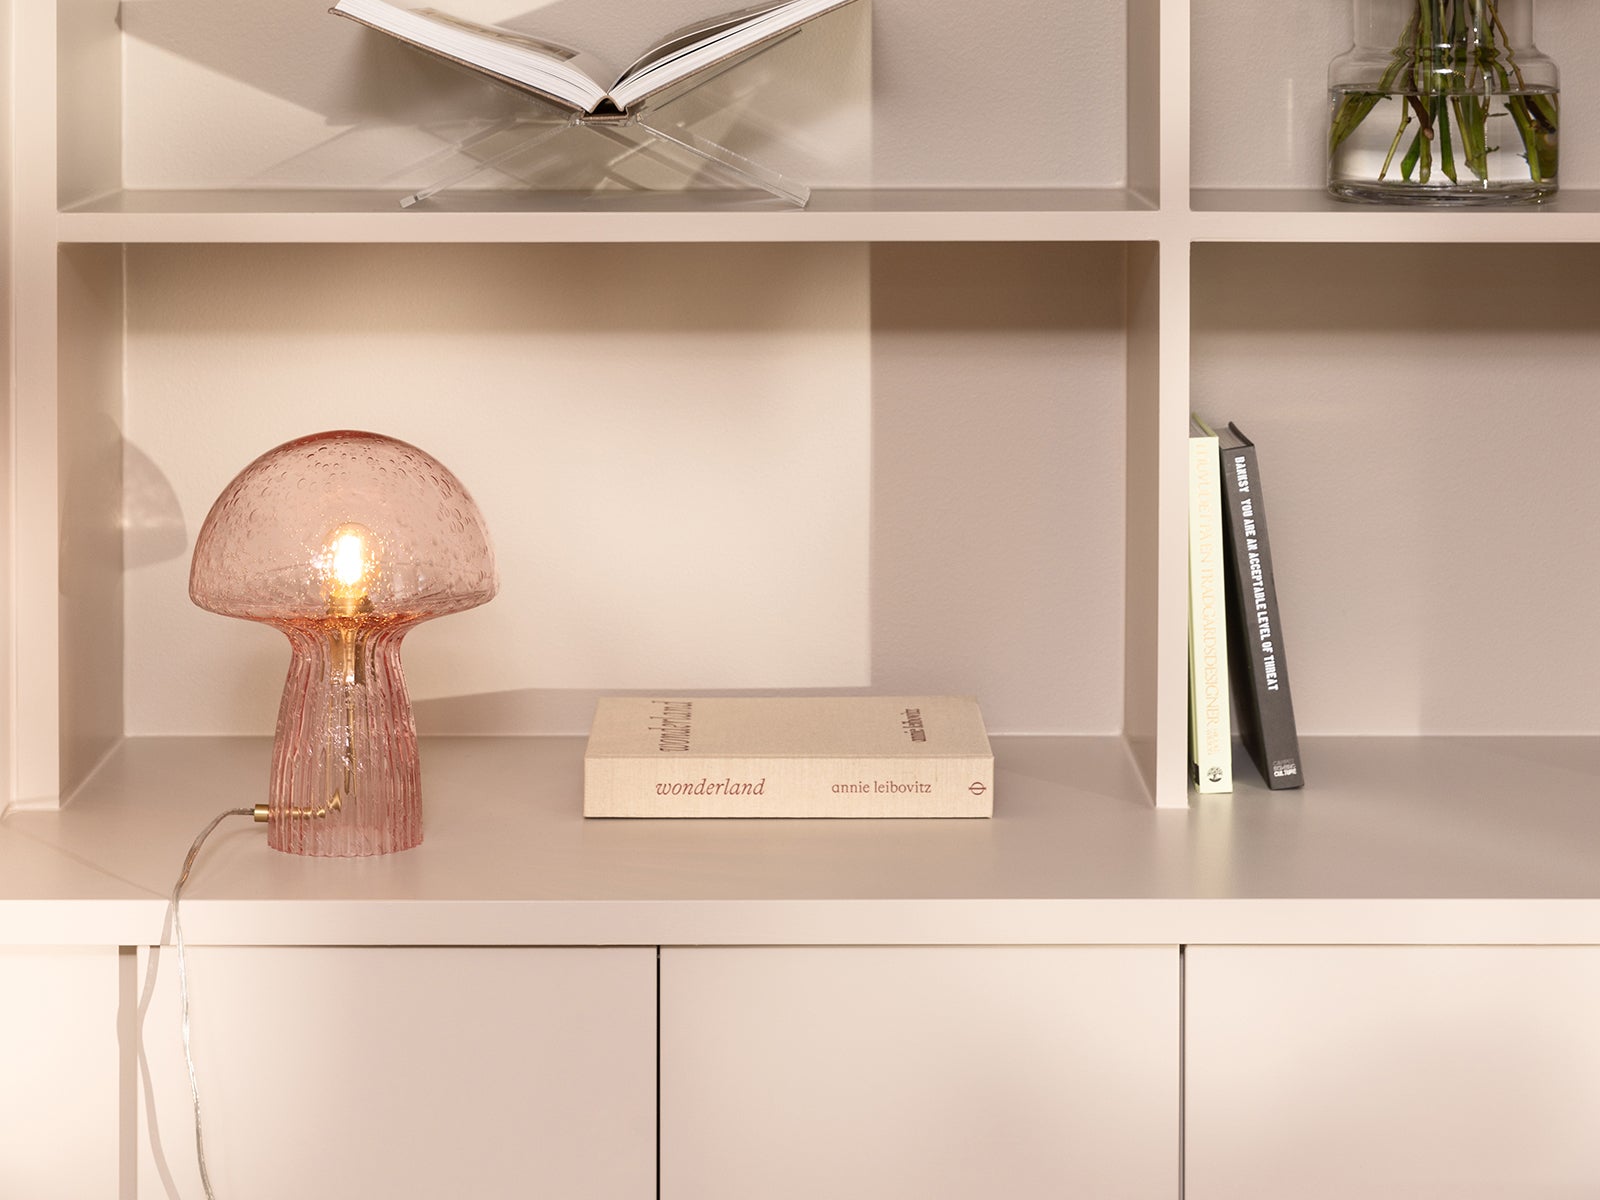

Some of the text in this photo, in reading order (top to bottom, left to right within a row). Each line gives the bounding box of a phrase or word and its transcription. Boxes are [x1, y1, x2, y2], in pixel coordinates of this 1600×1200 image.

[1235, 456, 1278, 691] BANKSY YOU ARE AN ACCEPTABLE LEVEL OF THREAT
[648, 700, 693, 751] wonderland
[655, 778, 766, 795] wonderland
[831, 780, 932, 794] annie leibovitz
